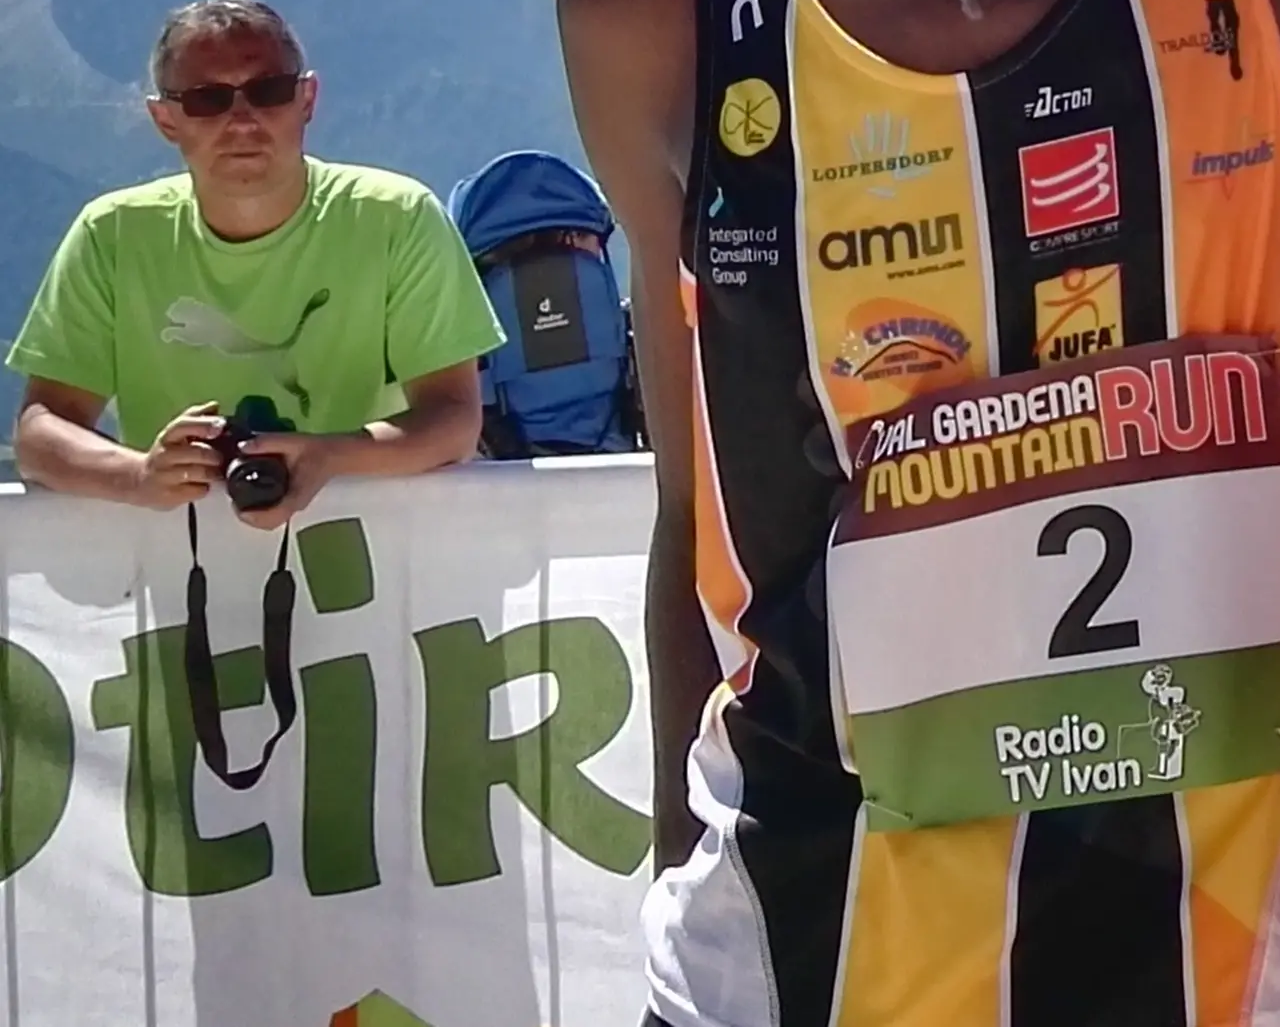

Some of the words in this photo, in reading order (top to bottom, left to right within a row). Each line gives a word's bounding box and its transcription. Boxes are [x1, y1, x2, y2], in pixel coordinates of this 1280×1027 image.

[812, 146, 954, 182] LOIPERSDORF
[712, 268, 748, 286] Group
[1048, 325, 1113, 362] JUFA
[872, 412, 927, 457] VAL
[932, 373, 1097, 445] GARDENA
[1096, 351, 1268, 461] RUN
[863, 416, 1103, 513] MOUNTAIN
[1036, 504, 1141, 659] 2
[995, 714, 1106, 762] Radio
[1001, 761, 1050, 802] TV
[1062, 759, 1142, 796] Ivan
